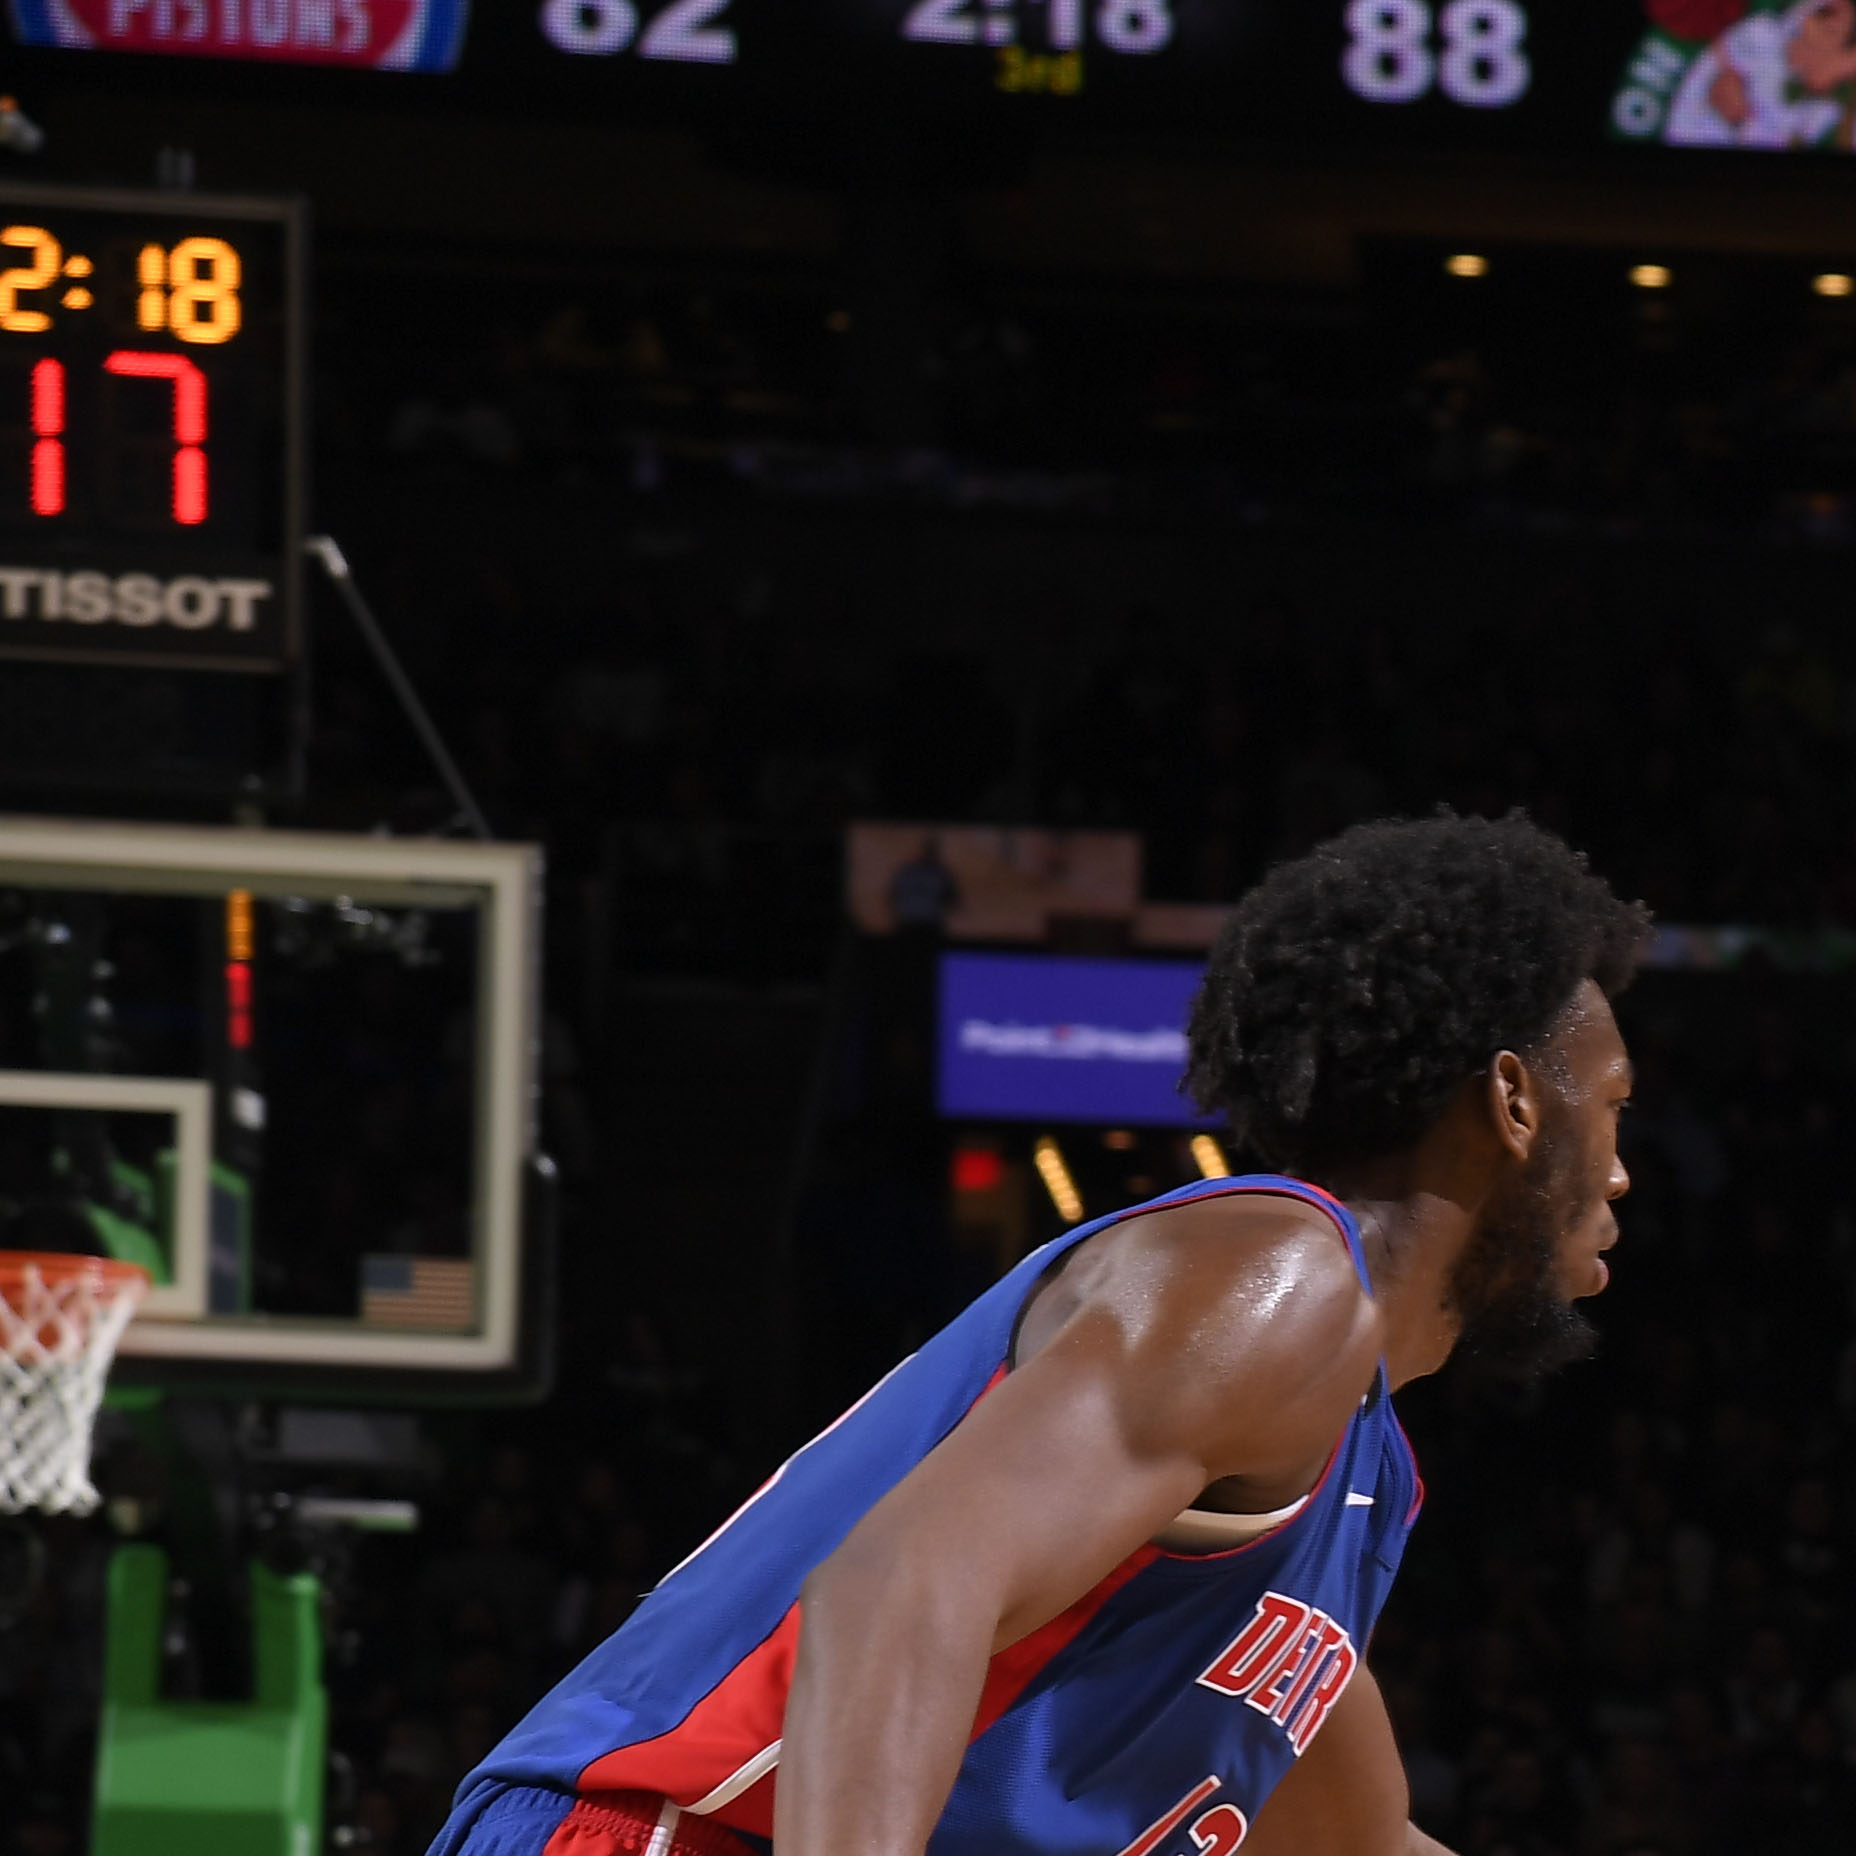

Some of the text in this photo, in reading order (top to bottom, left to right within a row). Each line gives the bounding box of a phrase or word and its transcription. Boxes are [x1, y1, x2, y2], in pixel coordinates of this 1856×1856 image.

[1341, 0, 1530, 107] 88
[0, 226, 242, 345] 2:18
[31, 350, 209, 525] 17
[0, 566, 270, 631] TISSOT
